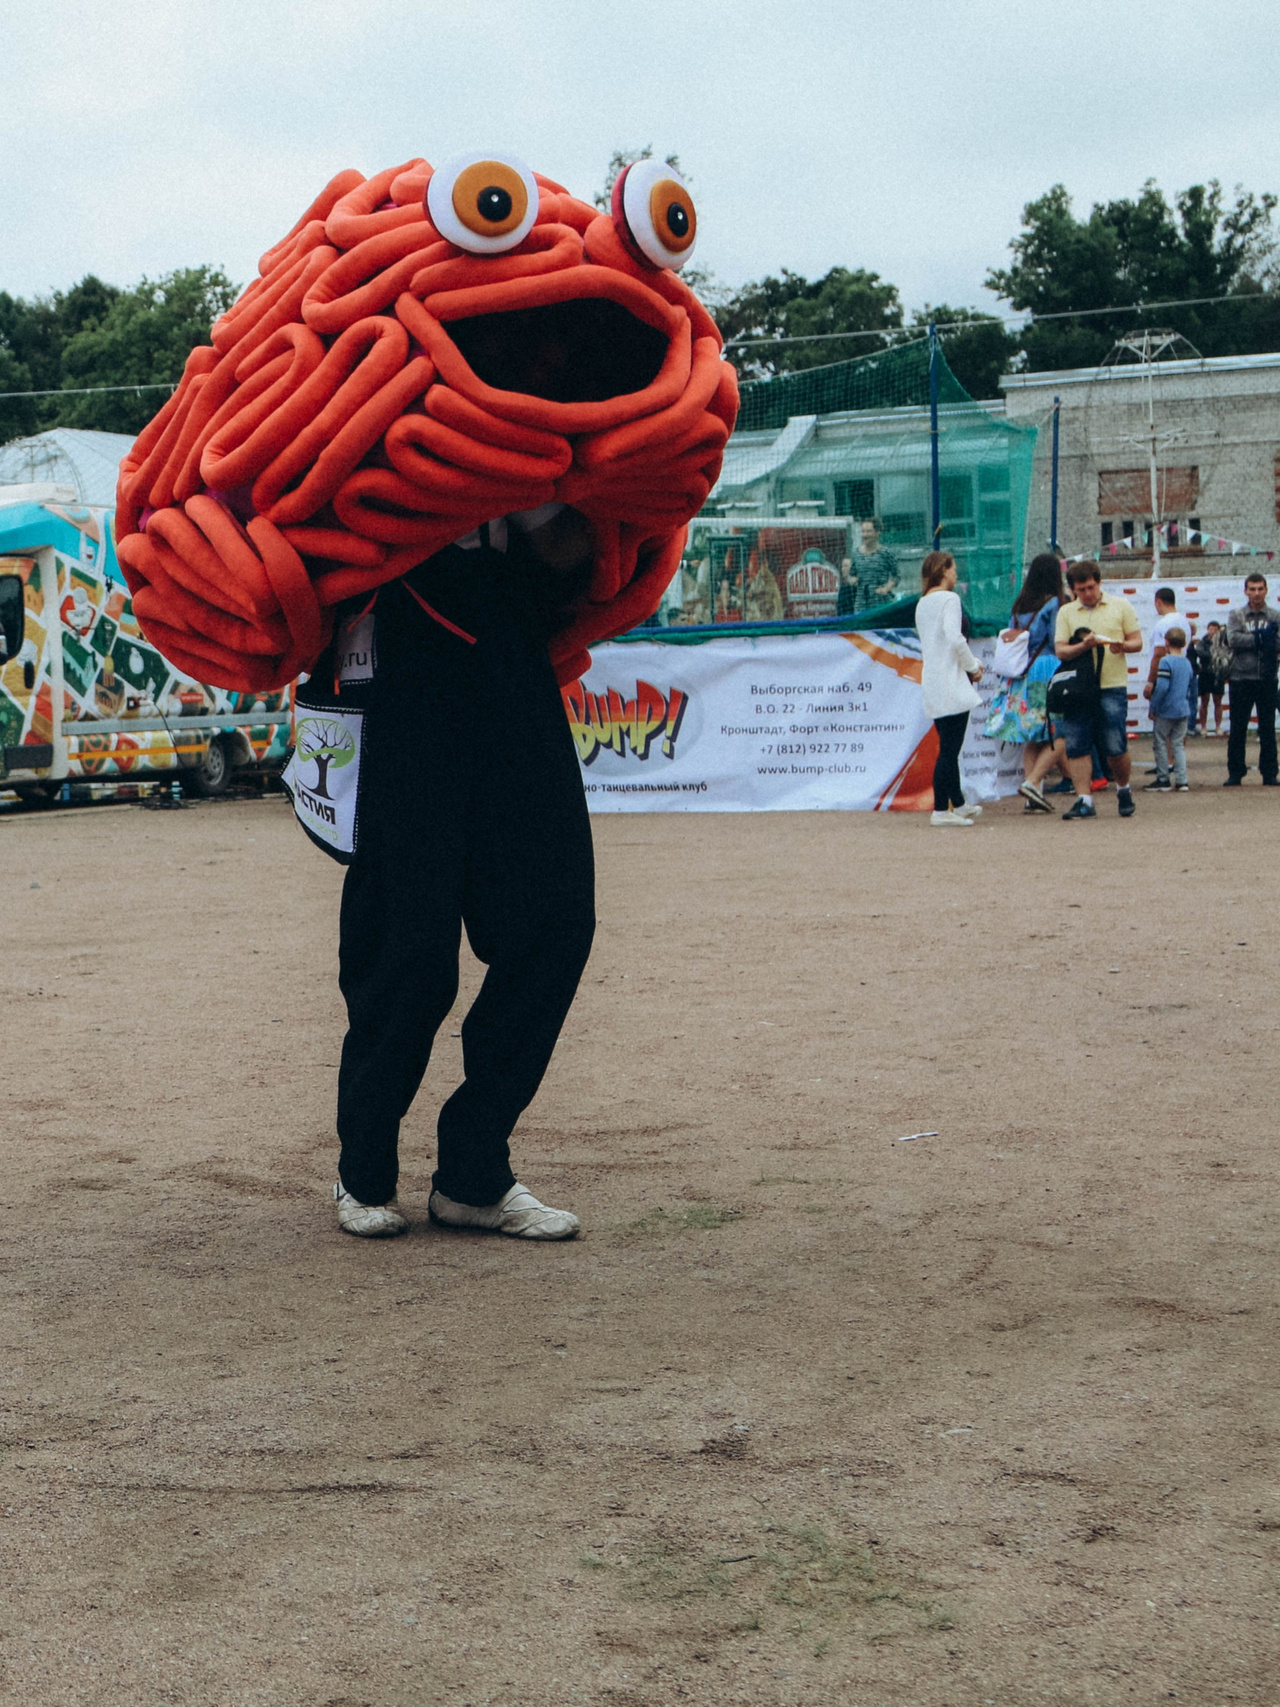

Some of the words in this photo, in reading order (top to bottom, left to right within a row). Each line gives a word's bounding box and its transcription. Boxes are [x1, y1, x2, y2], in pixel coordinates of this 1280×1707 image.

[750, 683, 824, 696] Выборгская
[827, 681, 854, 694] наб.
[857, 681, 873, 693] 49
[755, 703, 779, 715] В.О.
[782, 703, 796, 714] 22
[806, 702, 845, 714] Линия
[560, 678, 689, 767] BUMP!
[720, 724, 786, 737] Кронштадт,
[789, 723, 820, 736] Форт
[822, 722, 906, 734] «Константин»
[760, 744, 774, 755] +7
[776, 742, 807, 757] (812)
[809, 742, 831, 754] 922
[833, 742, 848, 754] 77
[850, 742, 865, 754] 89
[756, 763, 867, 777] www.bump-club.ru
[681, 781, 708, 794] клуб
